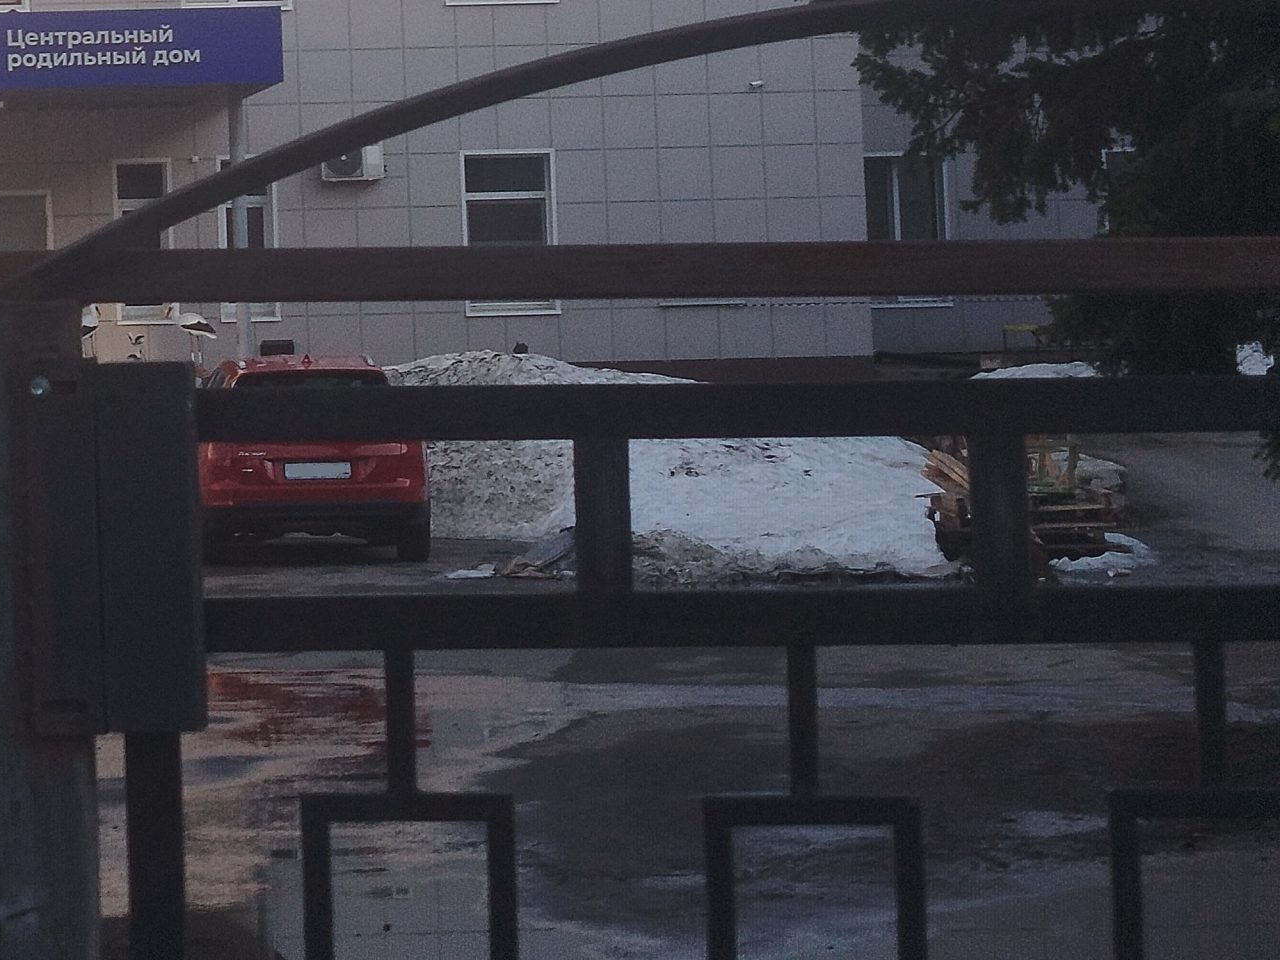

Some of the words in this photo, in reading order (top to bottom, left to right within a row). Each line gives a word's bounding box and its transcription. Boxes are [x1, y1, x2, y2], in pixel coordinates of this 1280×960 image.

[7, 24, 174, 49] Центральный
[7, 46, 146, 71] родильный
[153, 49, 201, 67] дом
